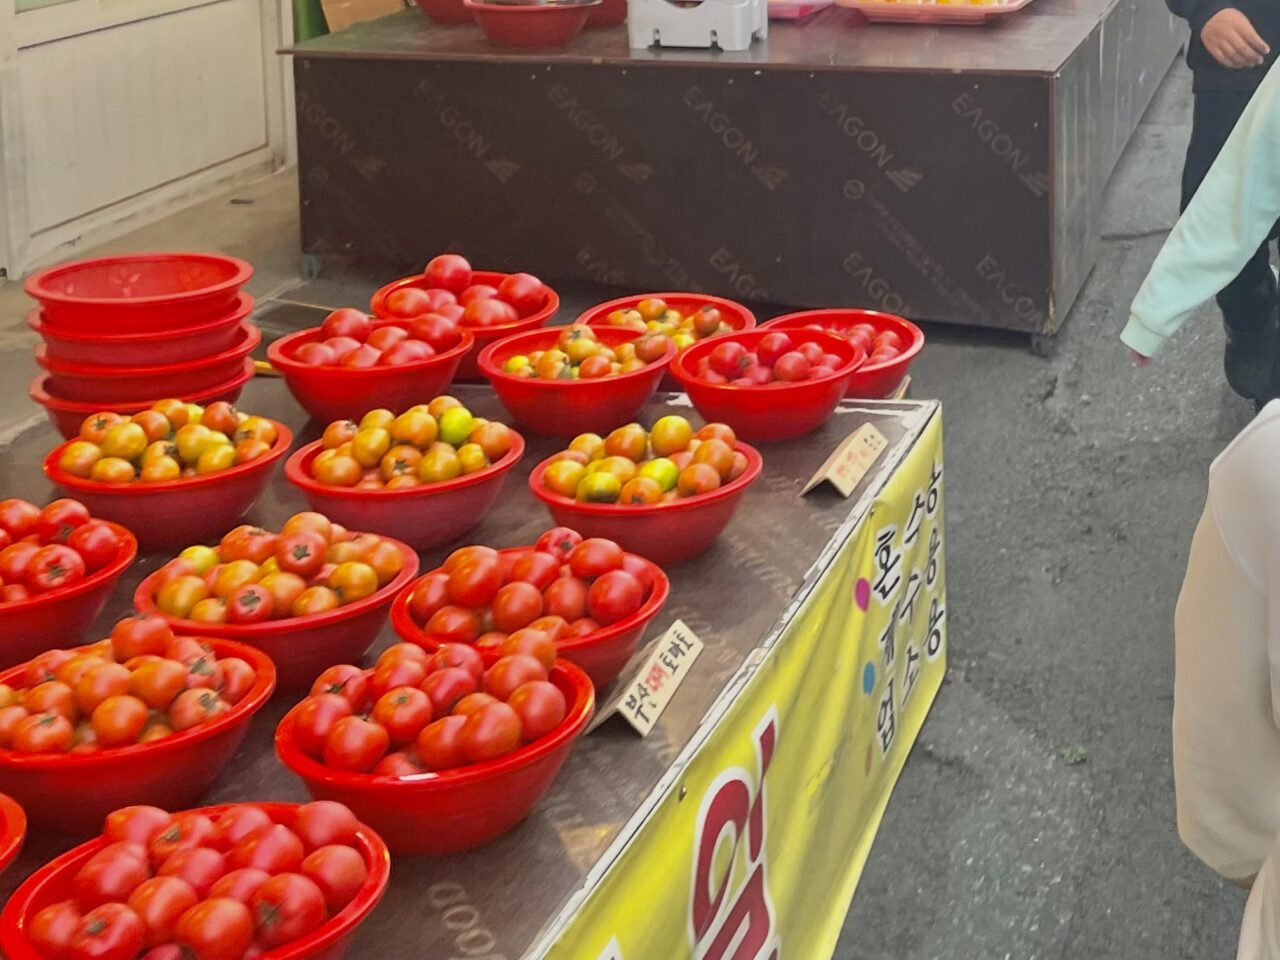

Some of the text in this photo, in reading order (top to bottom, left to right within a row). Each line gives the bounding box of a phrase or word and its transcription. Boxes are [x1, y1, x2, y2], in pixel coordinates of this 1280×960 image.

[818, 87, 895, 168] EAGON
[952, 90, 1031, 171] EAGON
[659, 629, 694, 676] 토마토
